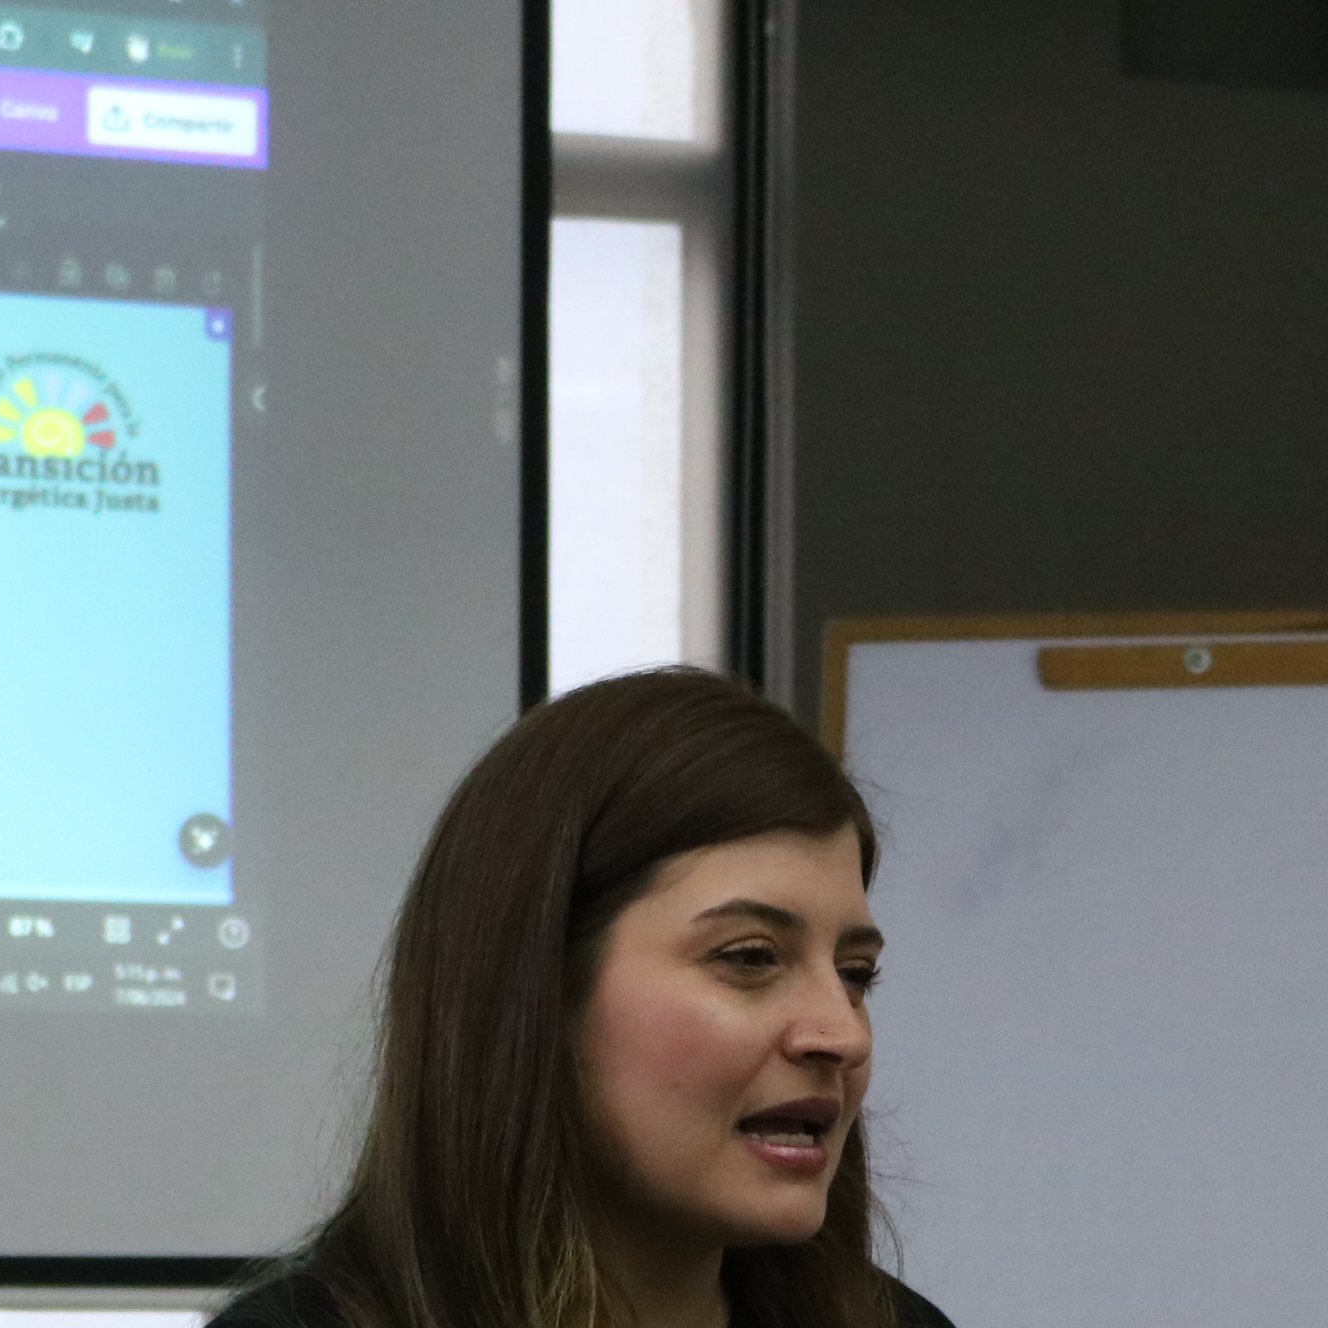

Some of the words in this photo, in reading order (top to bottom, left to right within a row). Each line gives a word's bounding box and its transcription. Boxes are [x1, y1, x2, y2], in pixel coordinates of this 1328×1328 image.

[0, 102, 58, 122] Canva
[142, 112, 234, 136] Compartir
[93, 489, 161, 514] Justa
